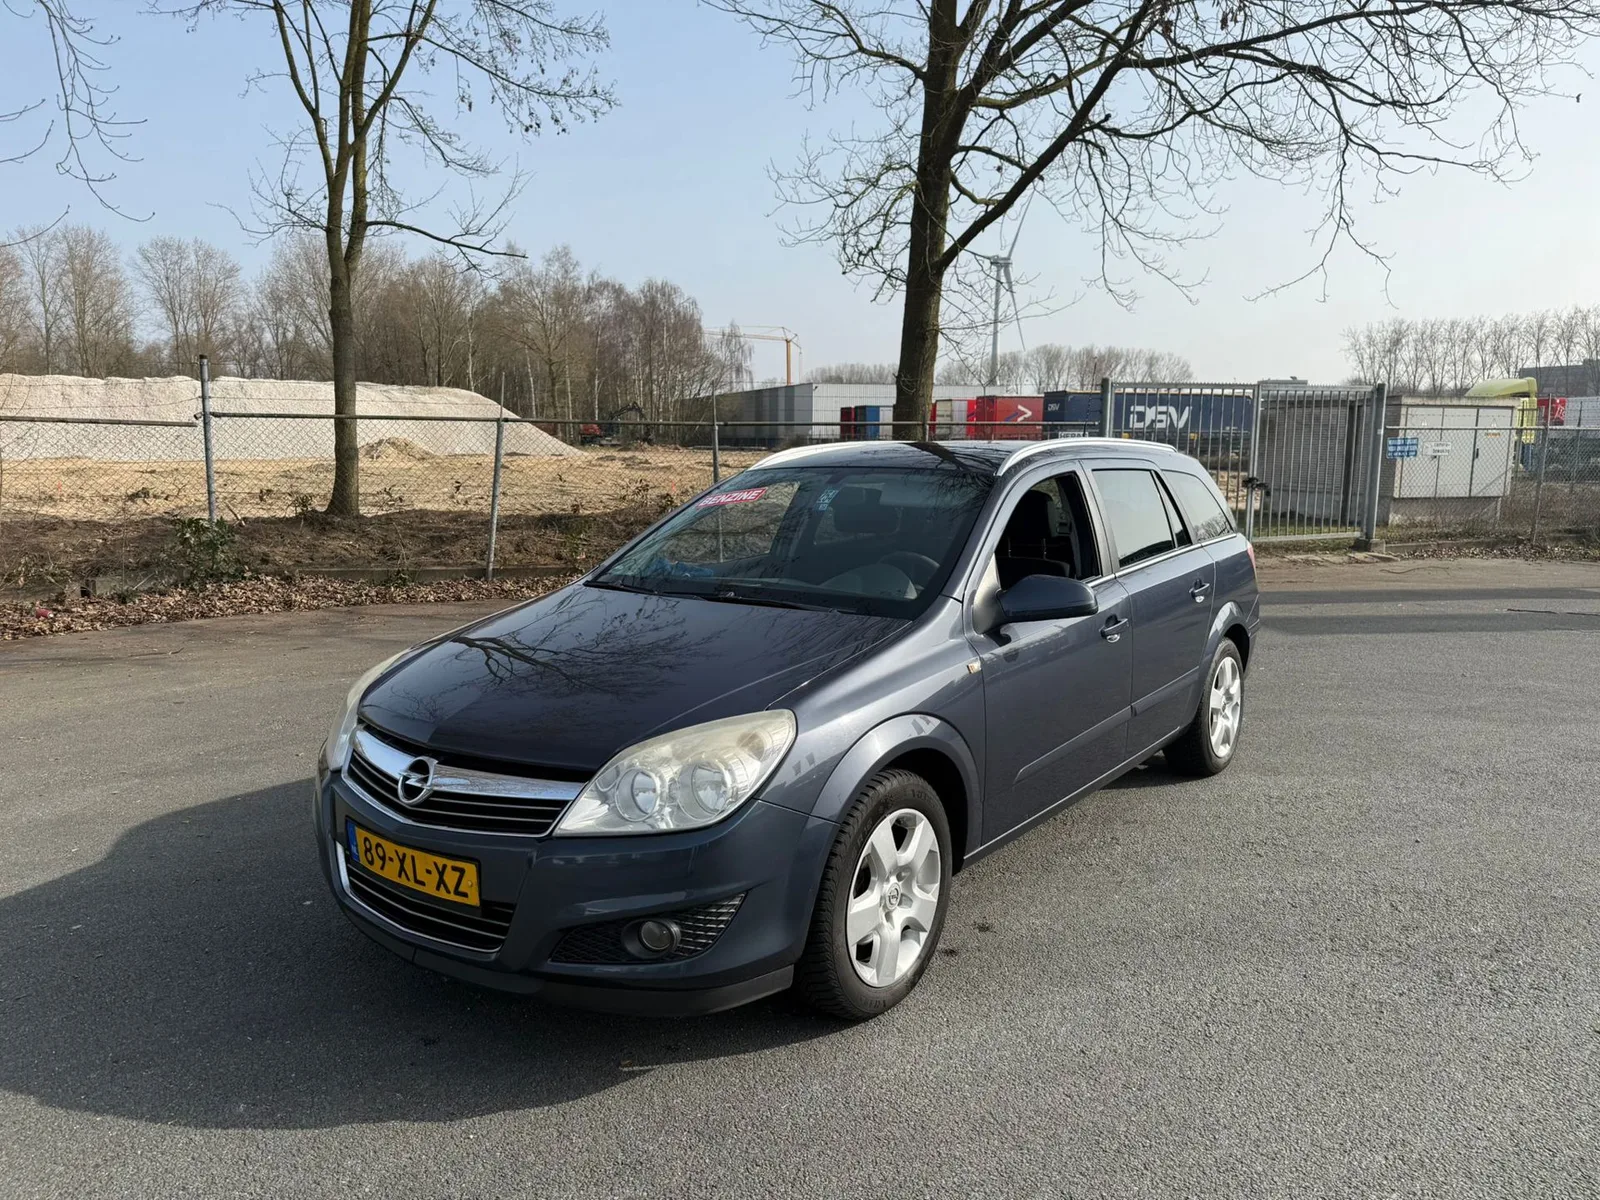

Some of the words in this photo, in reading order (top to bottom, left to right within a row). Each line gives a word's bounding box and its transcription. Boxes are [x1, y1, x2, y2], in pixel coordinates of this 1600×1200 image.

[1047, 403, 1060, 411] DSV
[1129, 405, 1193, 429] DSV
[700, 489, 762, 506] BENZINE
[363, 836, 469, 899] 89-XL-XZ
